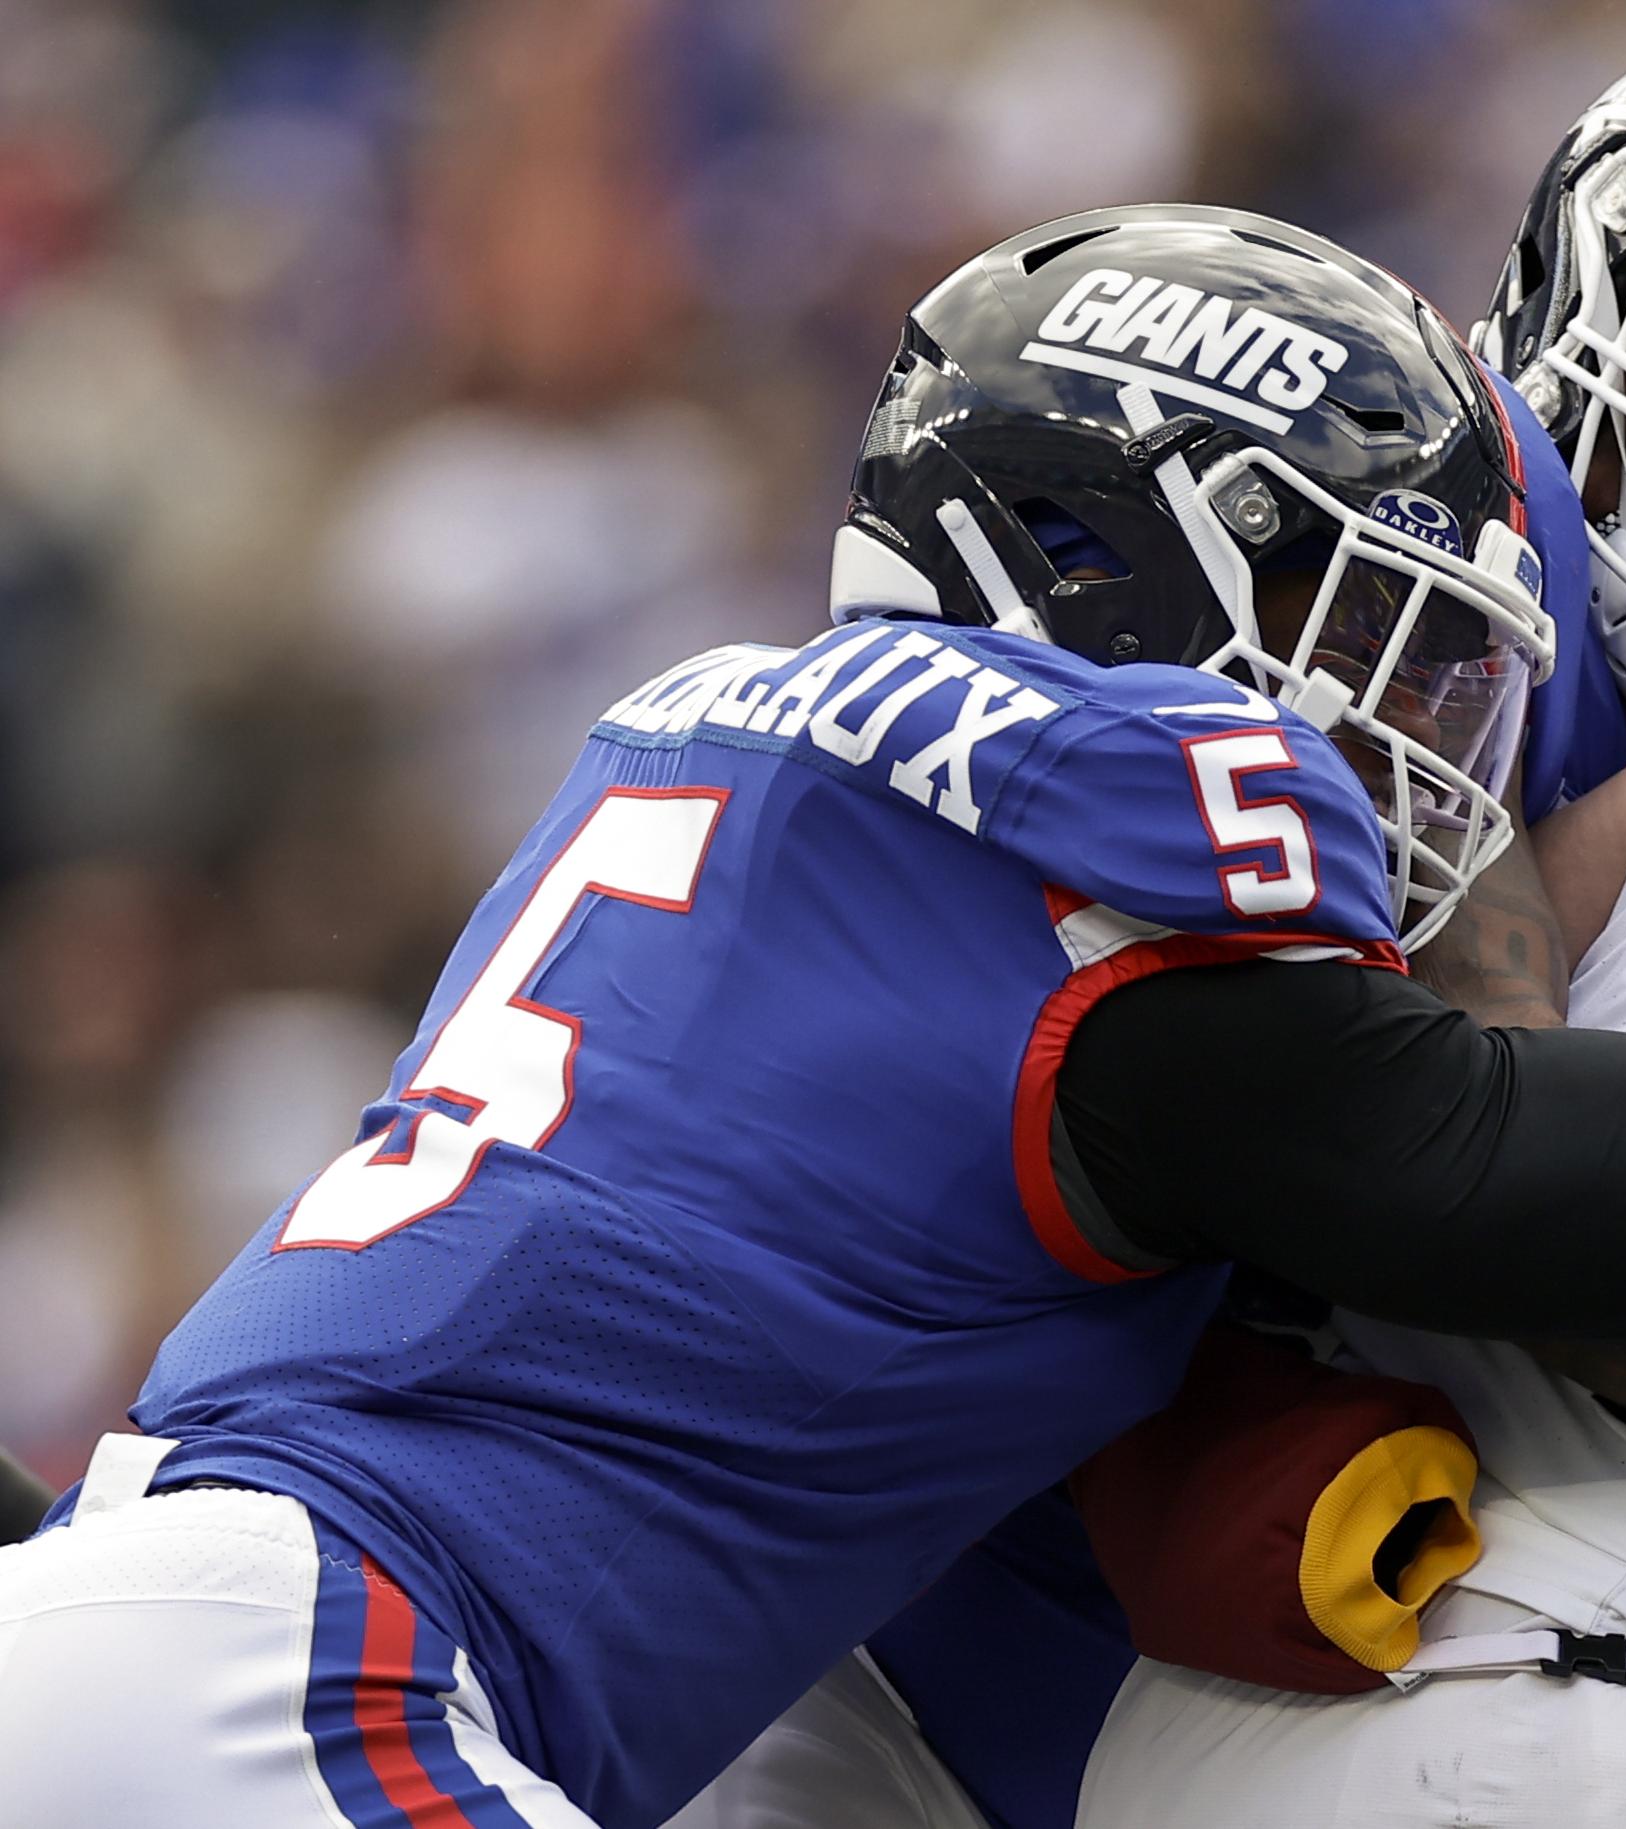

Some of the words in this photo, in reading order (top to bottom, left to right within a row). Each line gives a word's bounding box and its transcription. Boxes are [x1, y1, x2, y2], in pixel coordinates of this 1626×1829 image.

[1036, 267, 1350, 411] GIANTS
[1375, 506, 1456, 553] OAKLEY
[1178, 726, 1321, 921] 5
[270, 783, 733, 1254] 5
